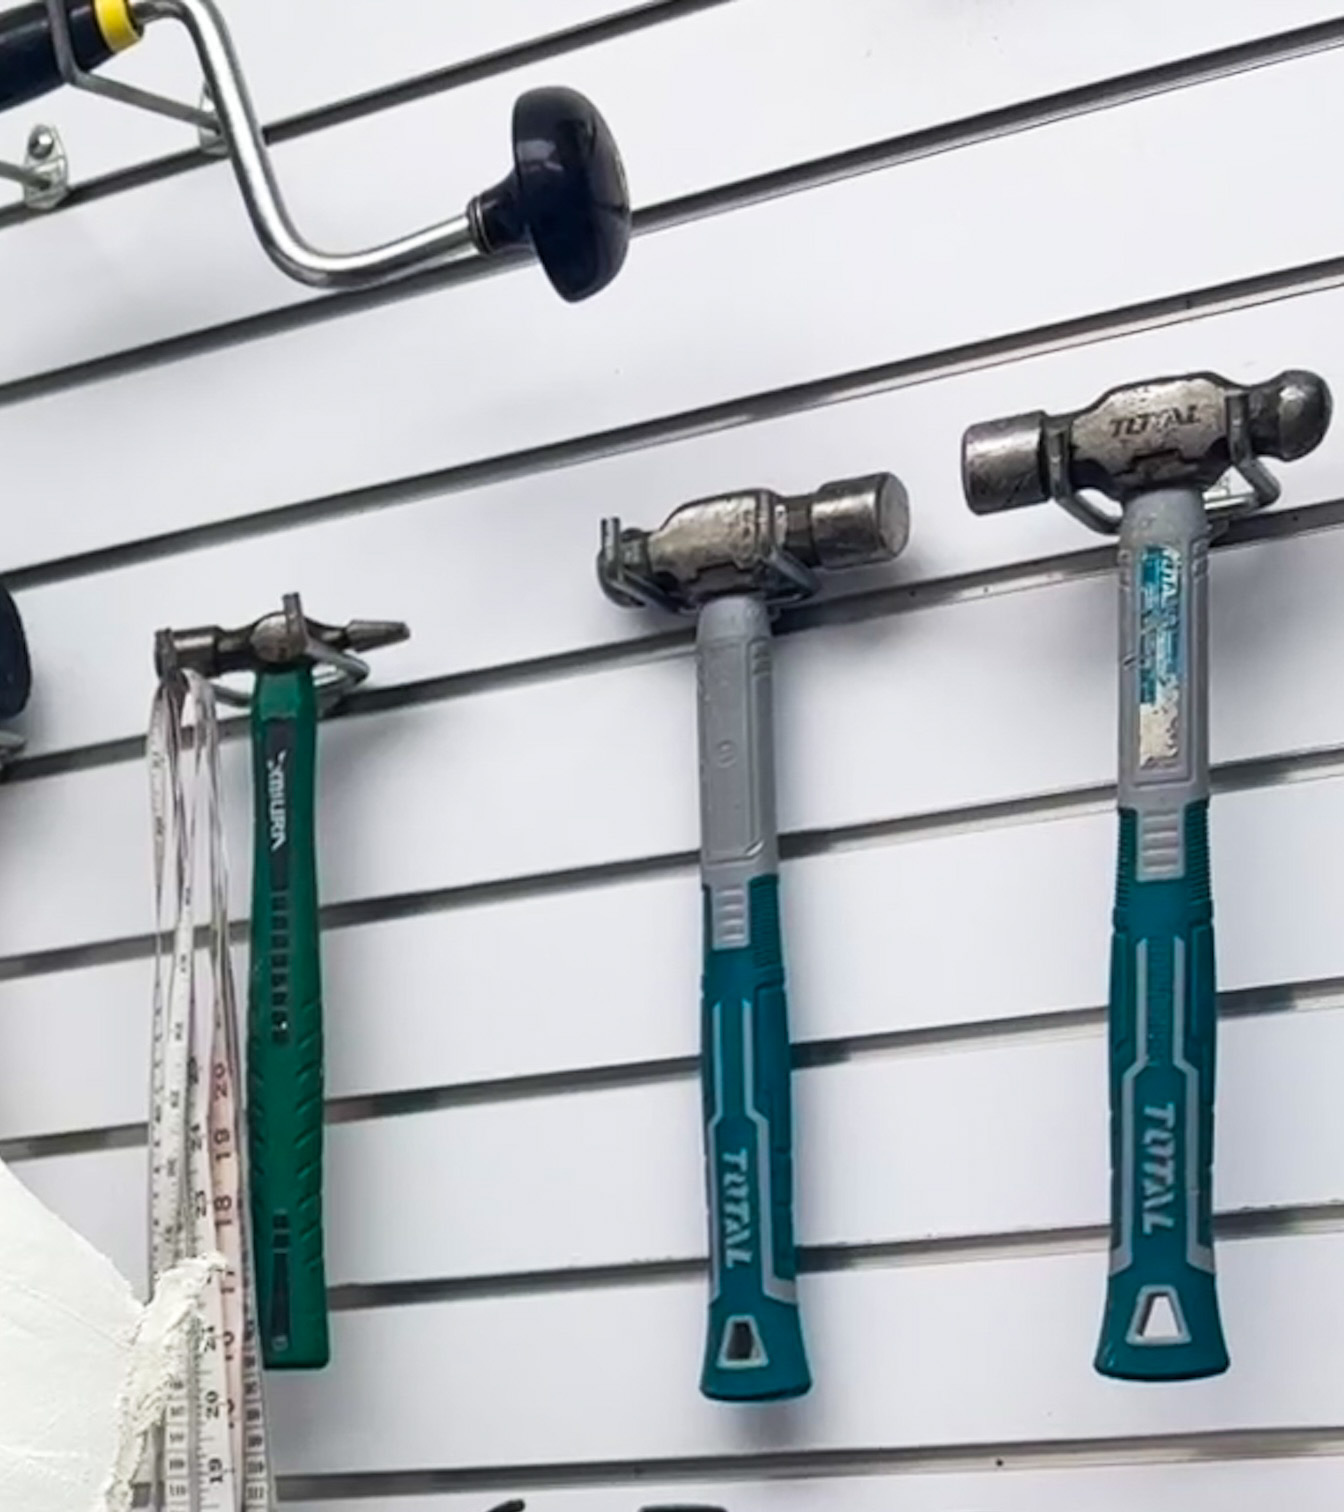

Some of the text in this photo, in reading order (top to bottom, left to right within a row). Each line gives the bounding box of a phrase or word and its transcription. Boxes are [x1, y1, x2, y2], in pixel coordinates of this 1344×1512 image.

[214, 1127, 231, 1162] 19
[1141, 1101, 1176, 1236] TOTAL
[214, 1194, 232, 1227] 18
[722, 1147, 753, 1269] TOTAL
[205, 1390, 219, 1419] 20
[208, 1457, 224, 1484] 19
